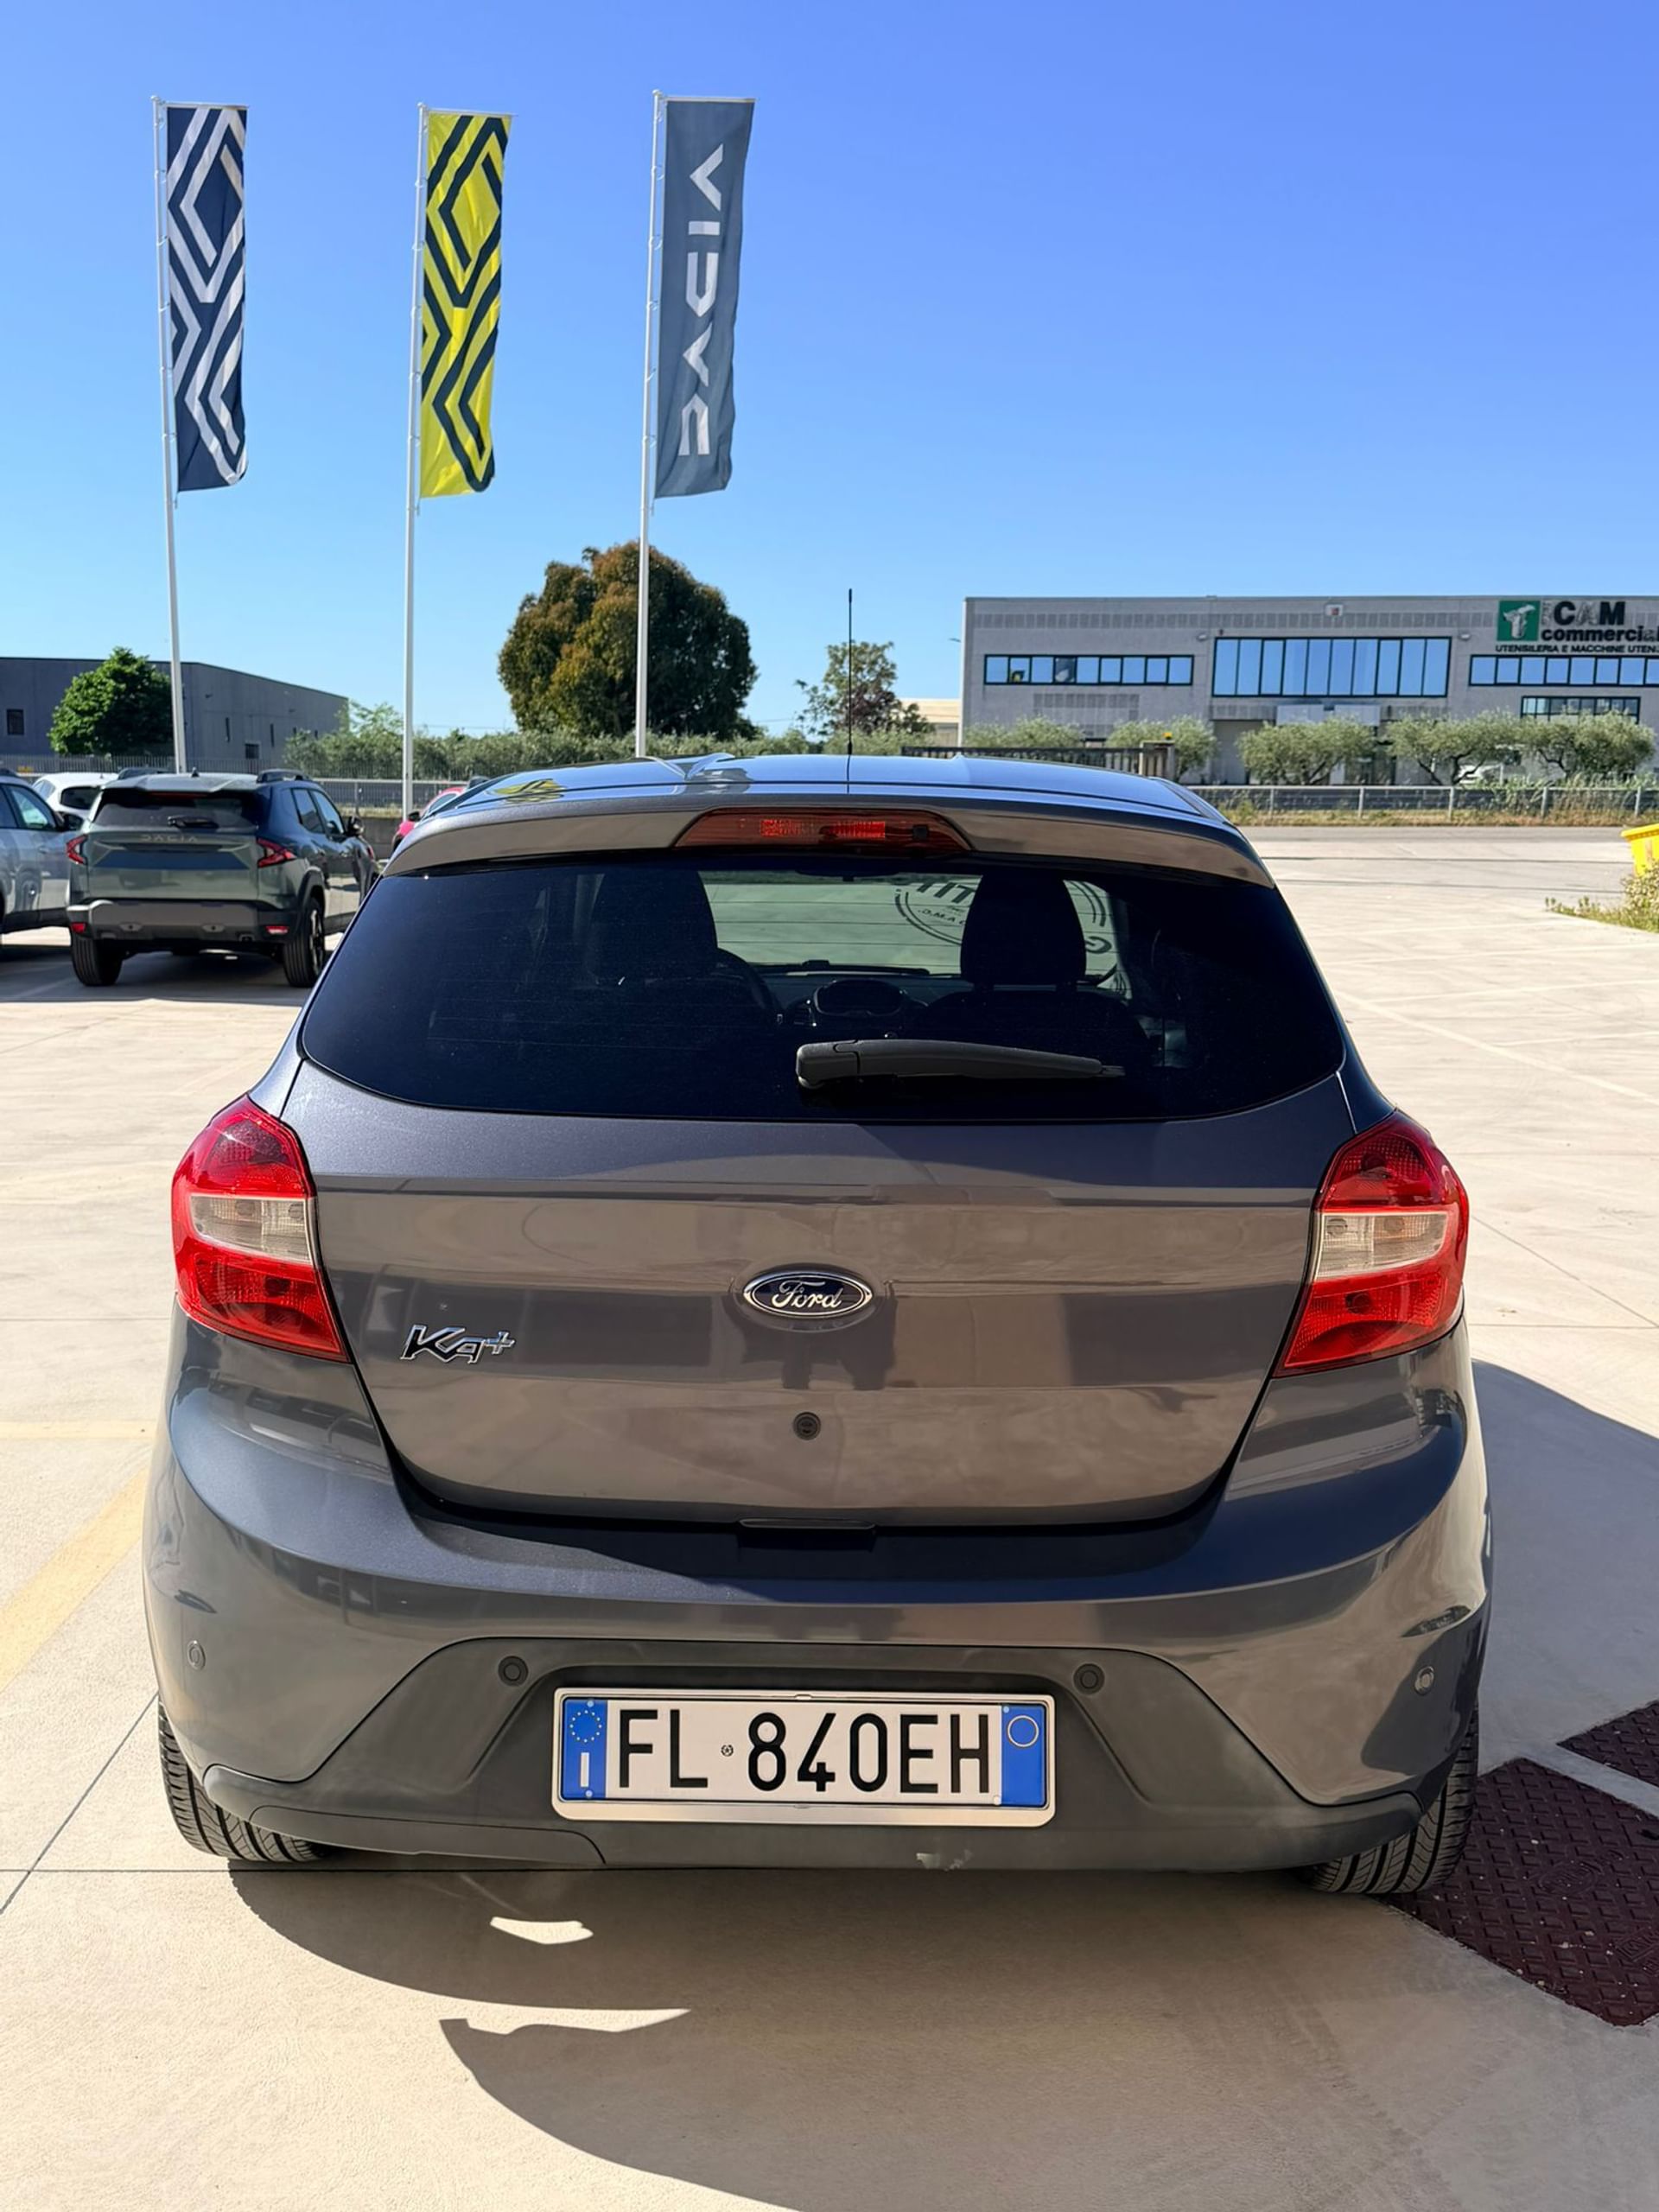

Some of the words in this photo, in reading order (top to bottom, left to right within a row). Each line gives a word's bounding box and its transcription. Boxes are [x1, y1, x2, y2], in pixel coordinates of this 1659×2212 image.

[678, 143, 723, 455] DACIA
[772, 1280, 844, 1308] Ford
[399, 1324, 516, 1364] Ka+
[619, 1709, 709, 1789] FL
[747, 1712, 989, 1794] 840EH
